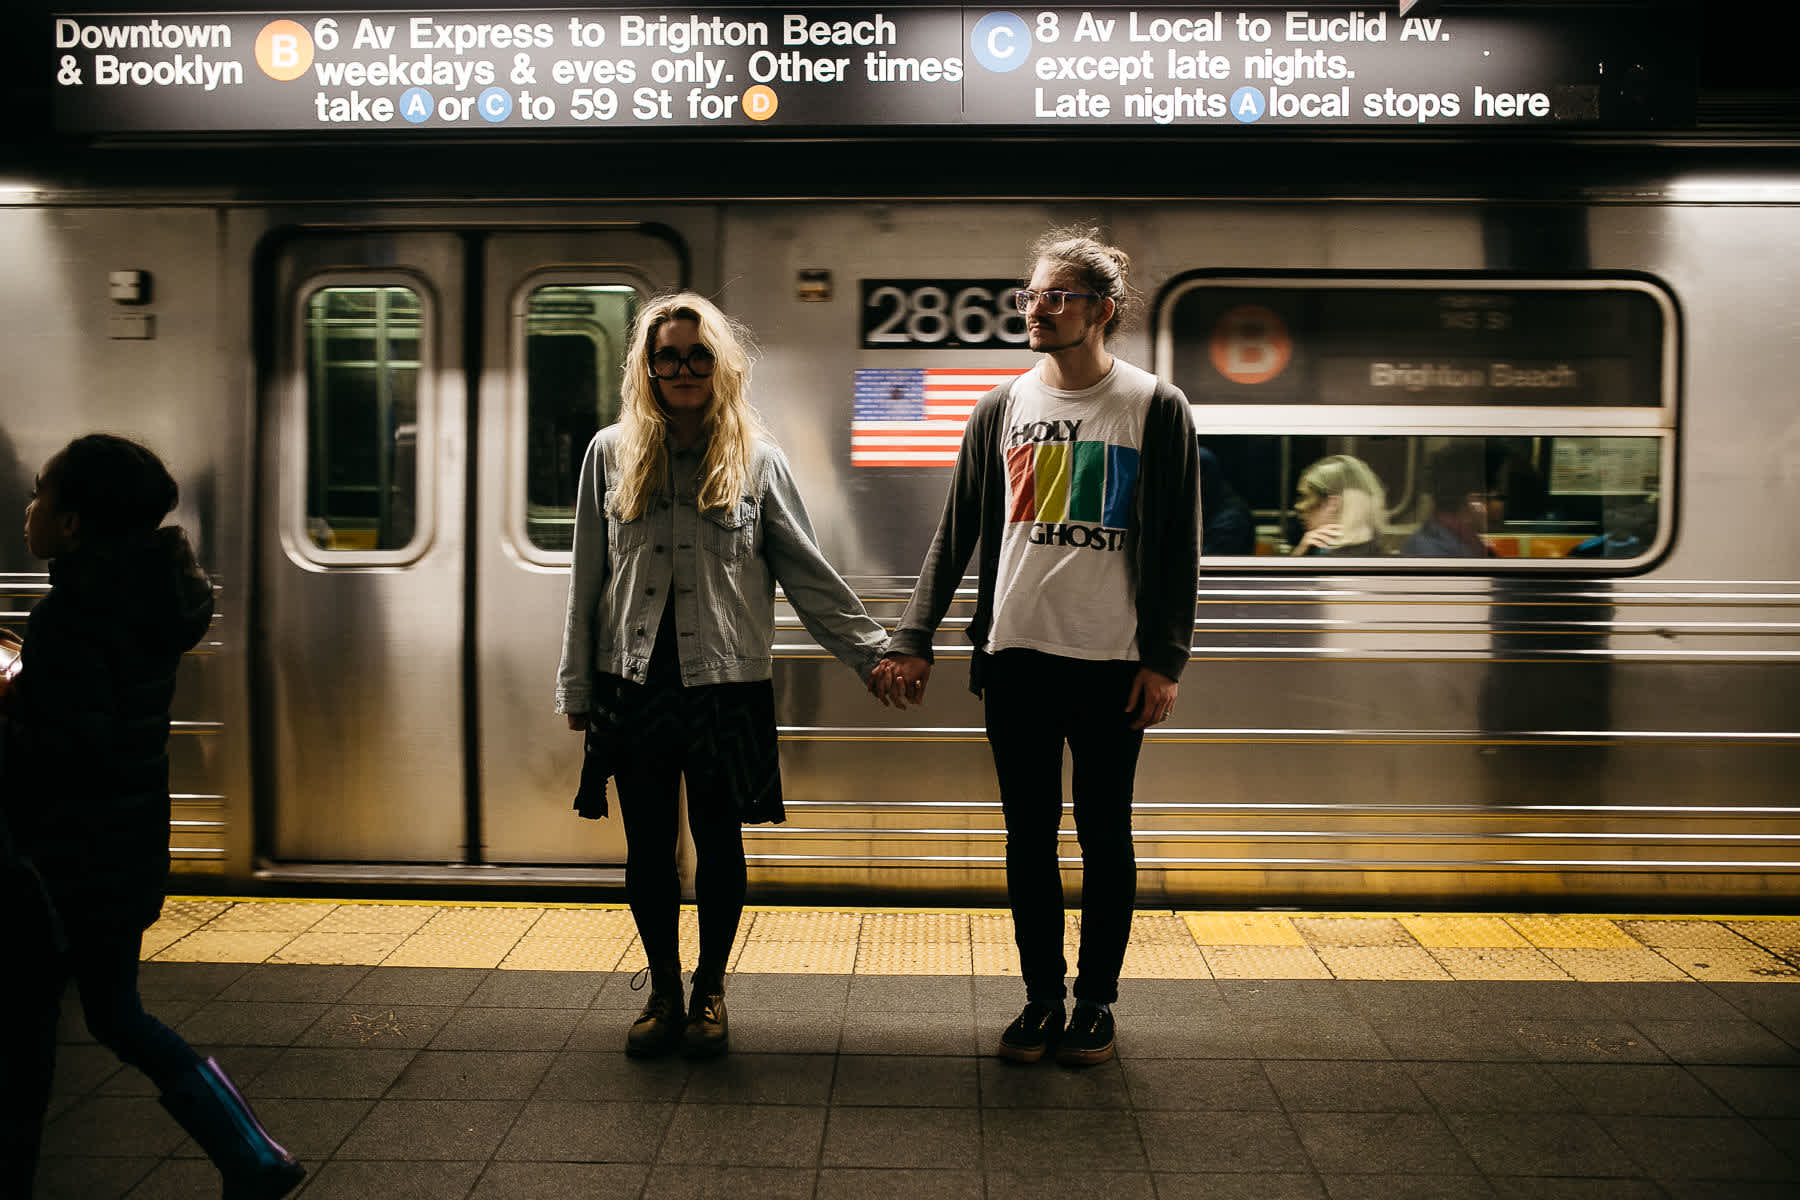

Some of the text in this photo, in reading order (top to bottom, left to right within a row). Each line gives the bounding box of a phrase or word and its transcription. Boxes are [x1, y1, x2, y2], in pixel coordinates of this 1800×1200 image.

[56, 19, 231, 48] Downtown
[314, 14, 896, 54] 6 Av Express to Brighton Beach
[987, 26, 1016, 58] C
[1035, 11, 1449, 42] 8 Av Local to Euclid Av.
[271, 34, 299, 67] B
[1035, 49, 1354, 86] except late nights.
[57, 55, 243, 90] & Brooklyn
[314, 50, 963, 90] weekdays & eves only. Other times
[314, 88, 769, 121] take A or C to 59 St for D
[1035, 86, 1549, 124] Late nights A local stops here
[865, 287, 1030, 344] 2868
[1226, 320, 1278, 374] B
[1370, 363, 1484, 391] Brighton
[1012, 419, 1082, 447] HOLY
